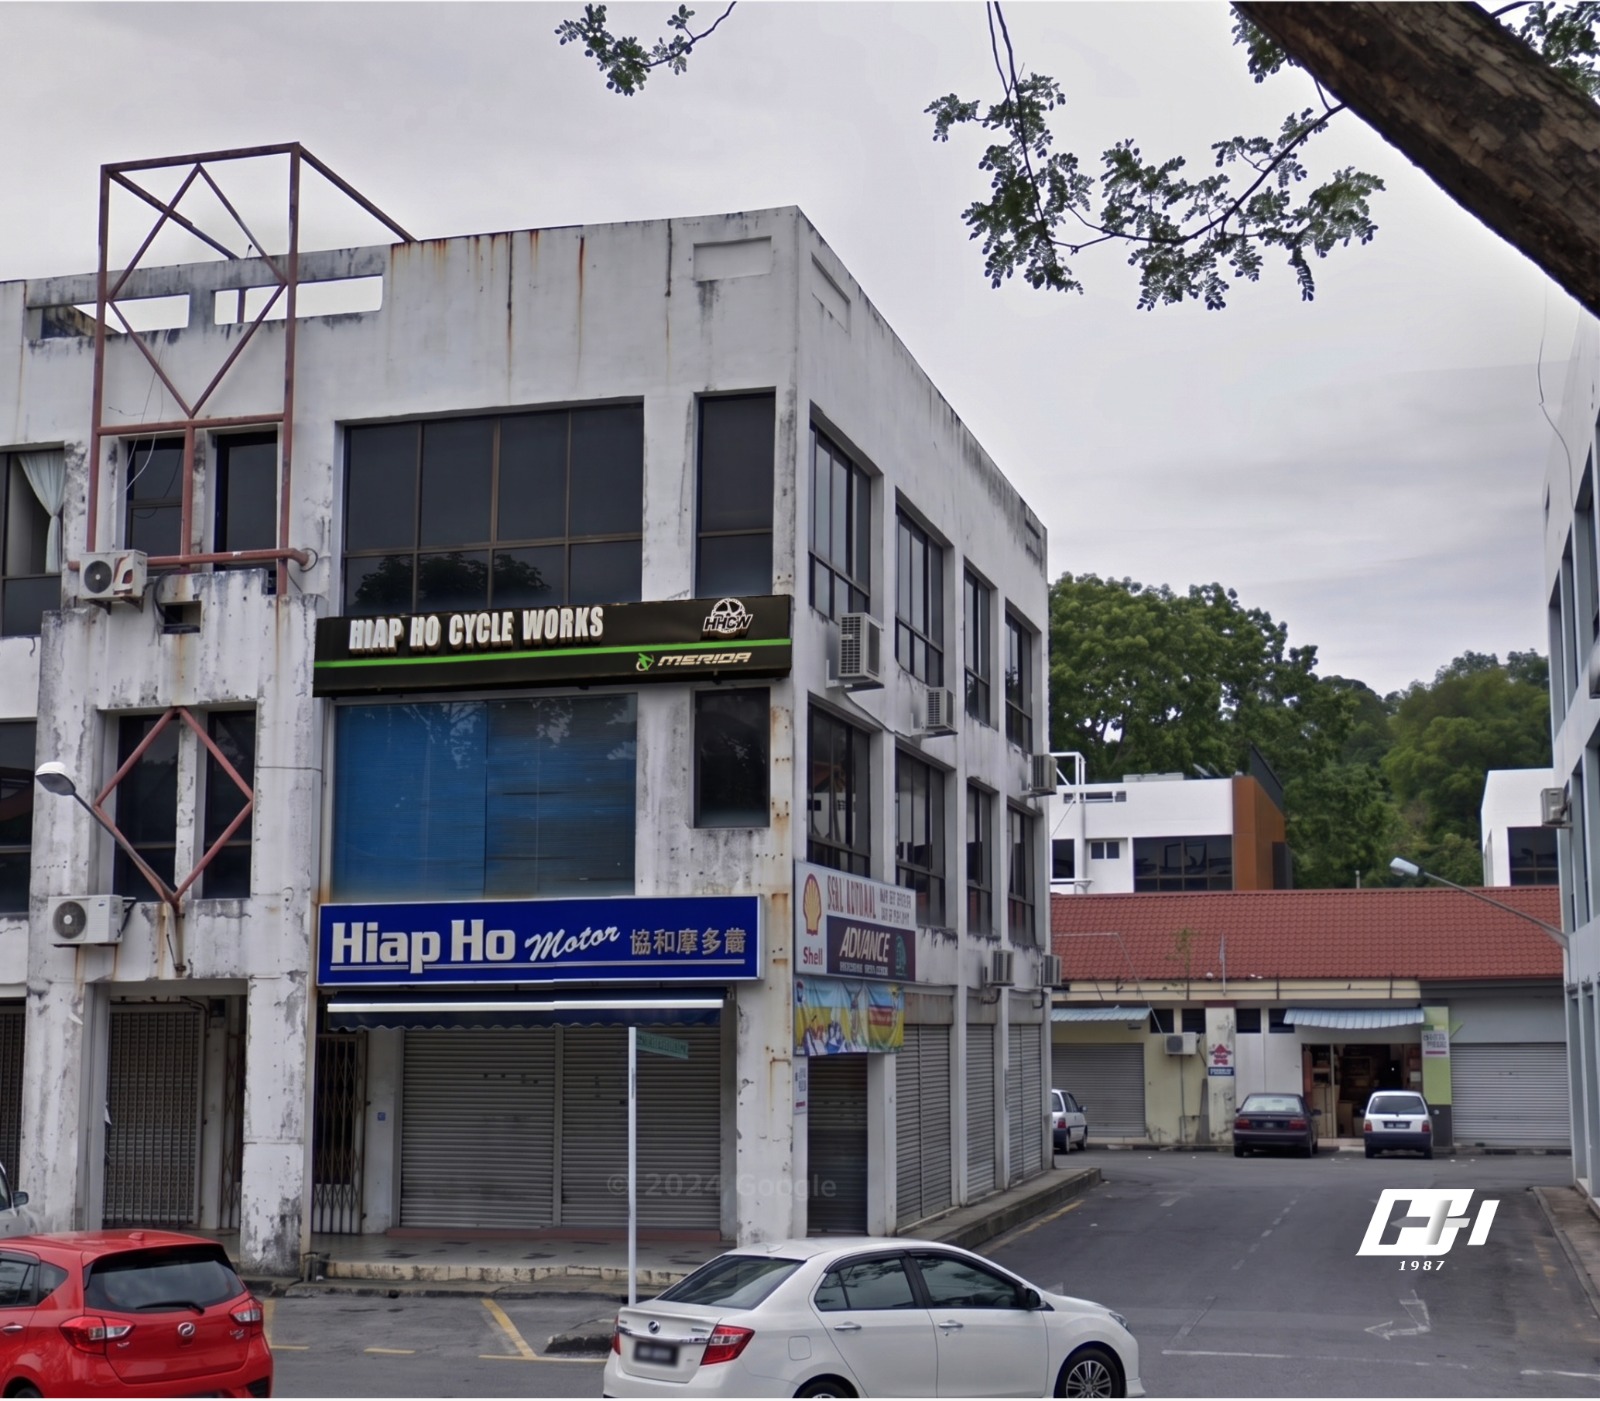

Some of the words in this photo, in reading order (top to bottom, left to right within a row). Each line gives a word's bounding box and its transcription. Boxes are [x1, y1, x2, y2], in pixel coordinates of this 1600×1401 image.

[348, 618, 402, 651] HIAP
[409, 615, 440, 650] HO
[449, 611, 514, 647] CYCLE
[523, 606, 604, 643] WORKS
[703, 614, 753, 632] HHCW
[658, 652, 752, 666] MERIDA
[331, 922, 441, 974] Hiap
[450, 919, 516, 961] Ho
[525, 926, 621, 962] Motor
[803, 946, 823, 966] Shell
[839, 926, 891, 963] ADVANCE
